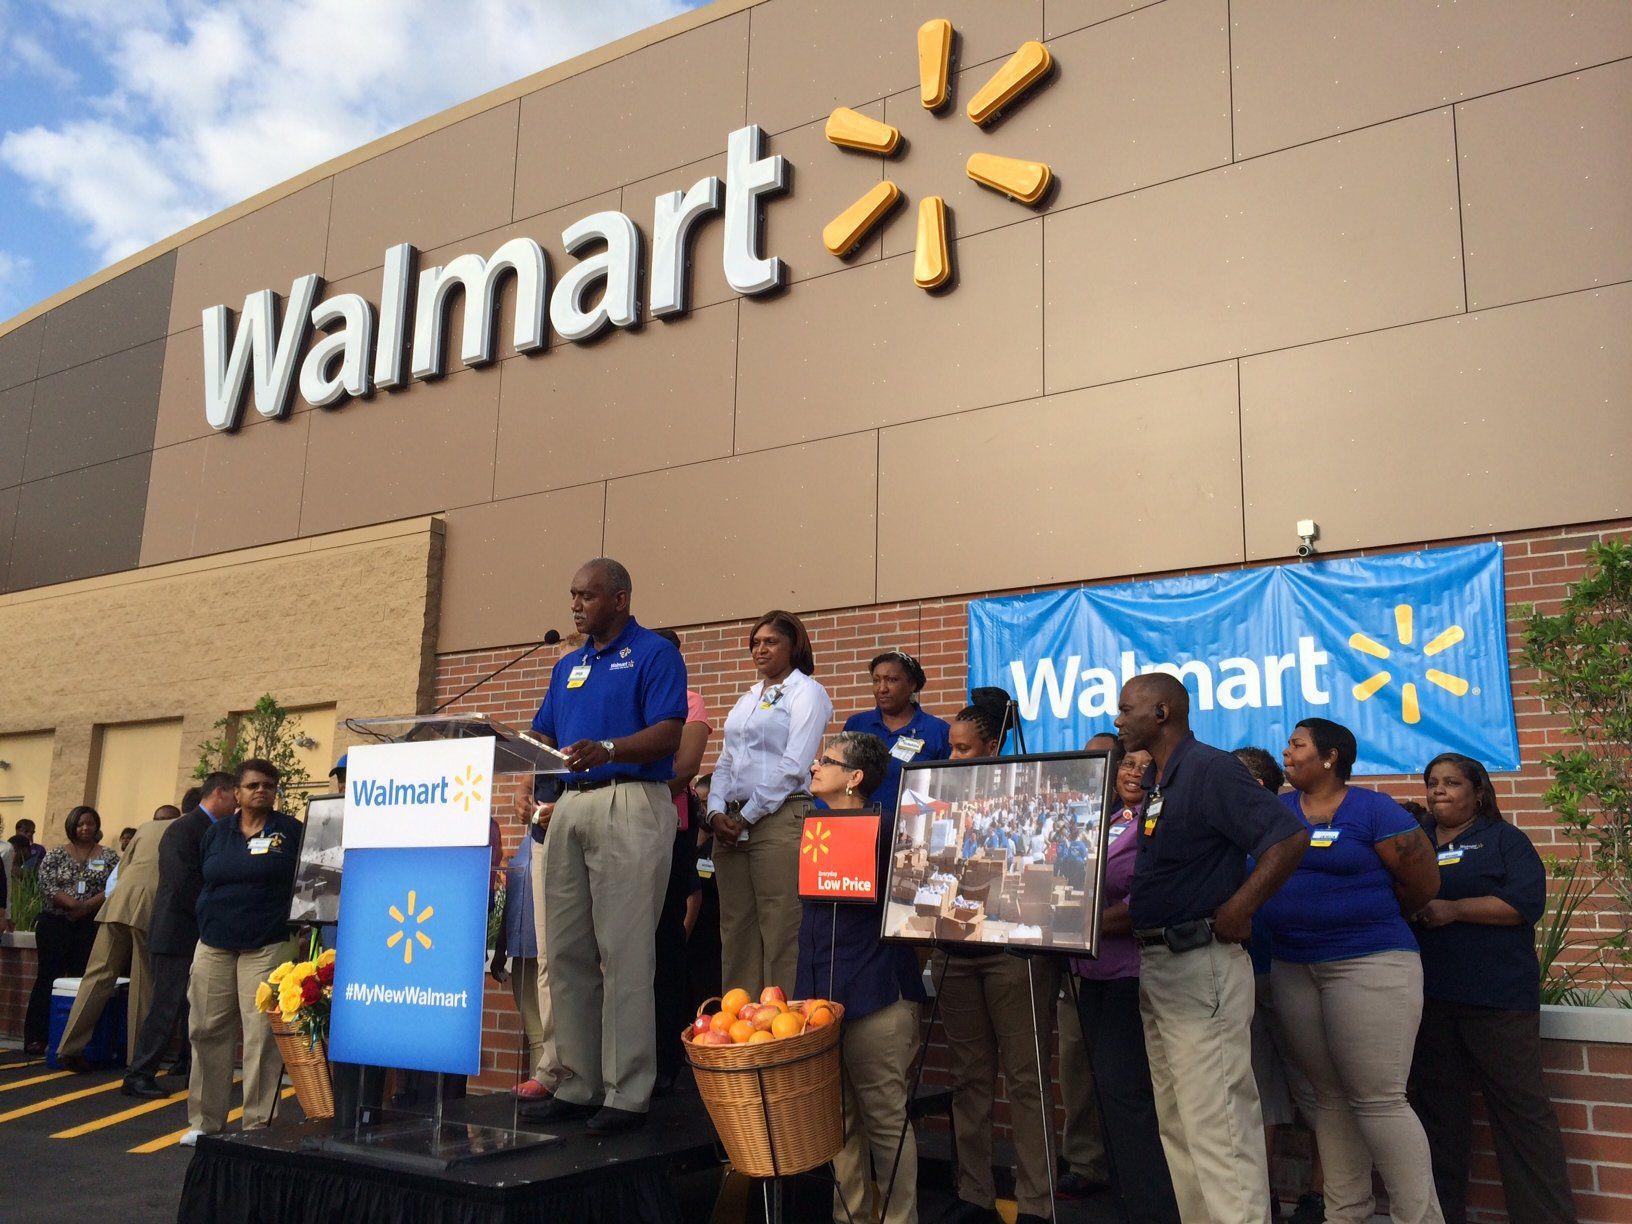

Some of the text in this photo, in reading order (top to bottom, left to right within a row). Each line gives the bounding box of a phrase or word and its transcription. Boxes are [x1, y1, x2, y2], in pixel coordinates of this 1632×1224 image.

[202, 124, 792, 430] Walmart
[352, 776, 449, 807] Walmart
[818, 877, 872, 891] Low Price
[345, 982, 468, 1008] #MyNewWalmart
